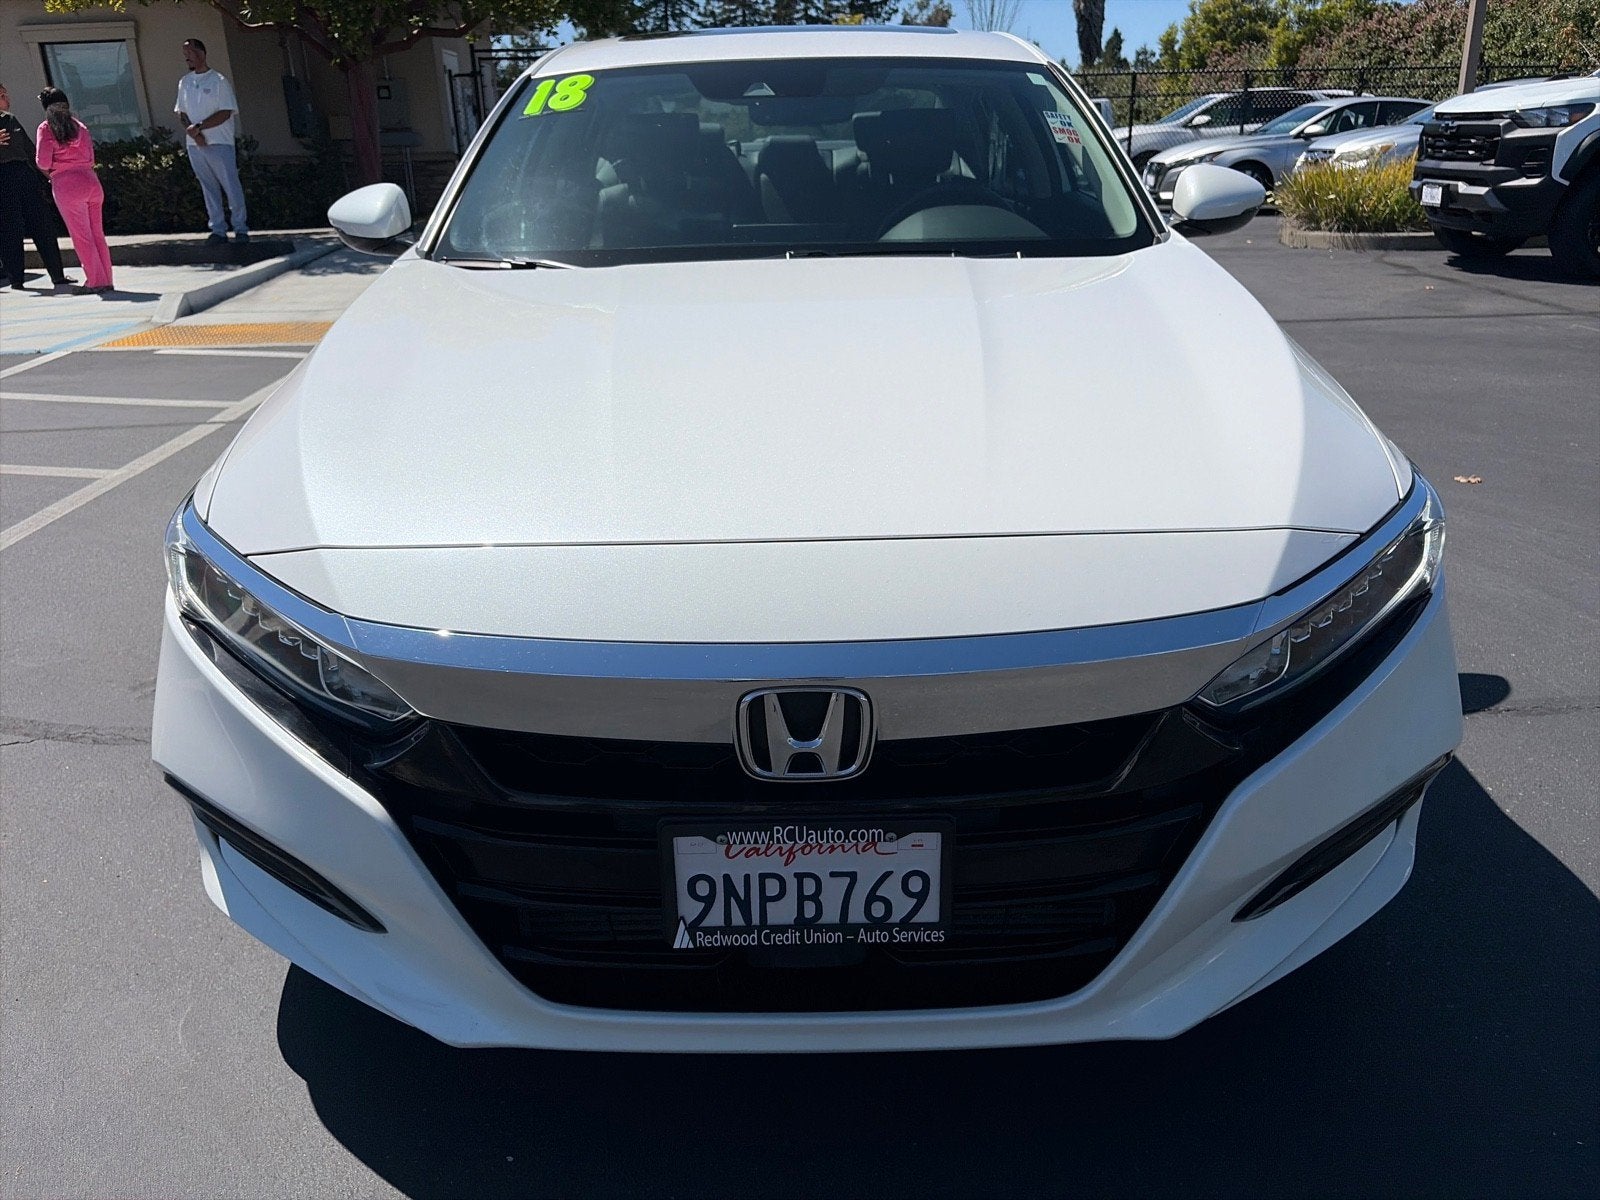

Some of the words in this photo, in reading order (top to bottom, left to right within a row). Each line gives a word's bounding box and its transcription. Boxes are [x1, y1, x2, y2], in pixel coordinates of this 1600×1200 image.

[523, 74, 595, 116] 18
[1045, 111, 1071, 121] SAFETY
[1060, 120, 1074, 128] OK
[1052, 127, 1079, 137] SMOG
[1067, 136, 1082, 144] OK
[727, 825, 884, 845] www.RCUauto.com
[687, 870, 931, 927] 9NPB769
[696, 930, 758, 947] Redwood
[761, 929, 801, 946] Credit
[804, 929, 843, 945] Union
[857, 928, 889, 943] Auto
[892, 927, 945, 943] Services
